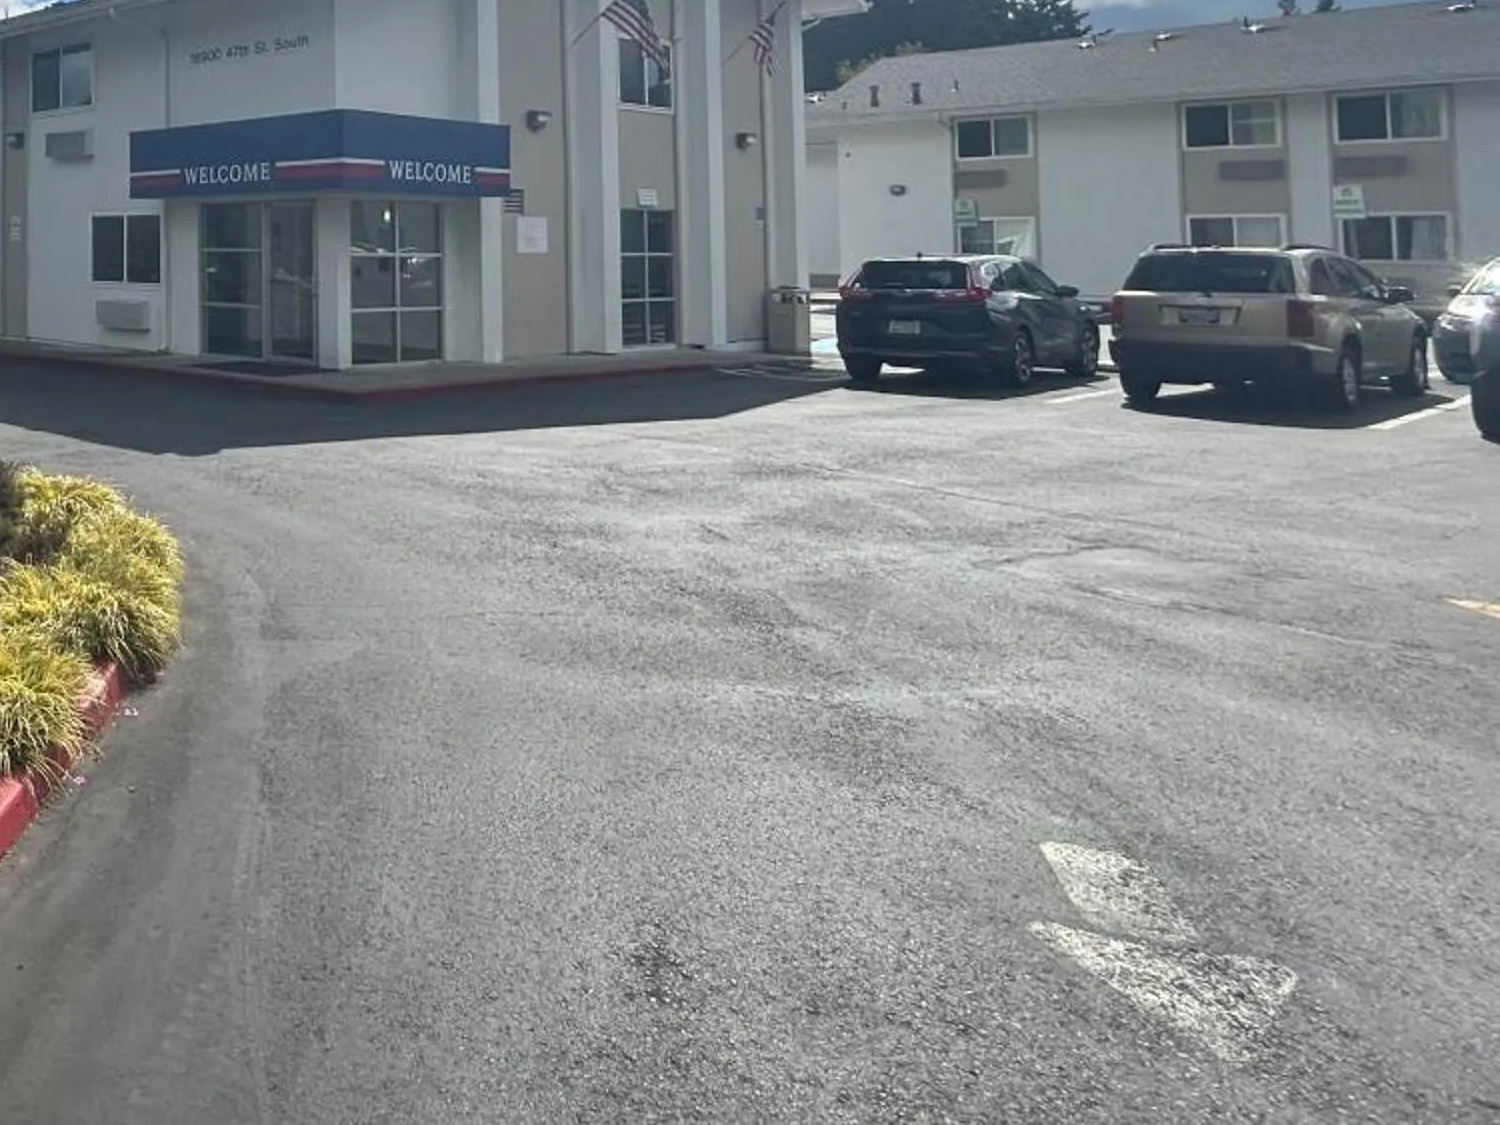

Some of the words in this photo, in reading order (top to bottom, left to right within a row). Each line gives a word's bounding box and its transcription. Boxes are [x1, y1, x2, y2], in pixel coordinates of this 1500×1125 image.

[274, 34, 310, 52] South
[185, 162, 271, 185] WELCOME
[389, 161, 473, 185] WELCOME
